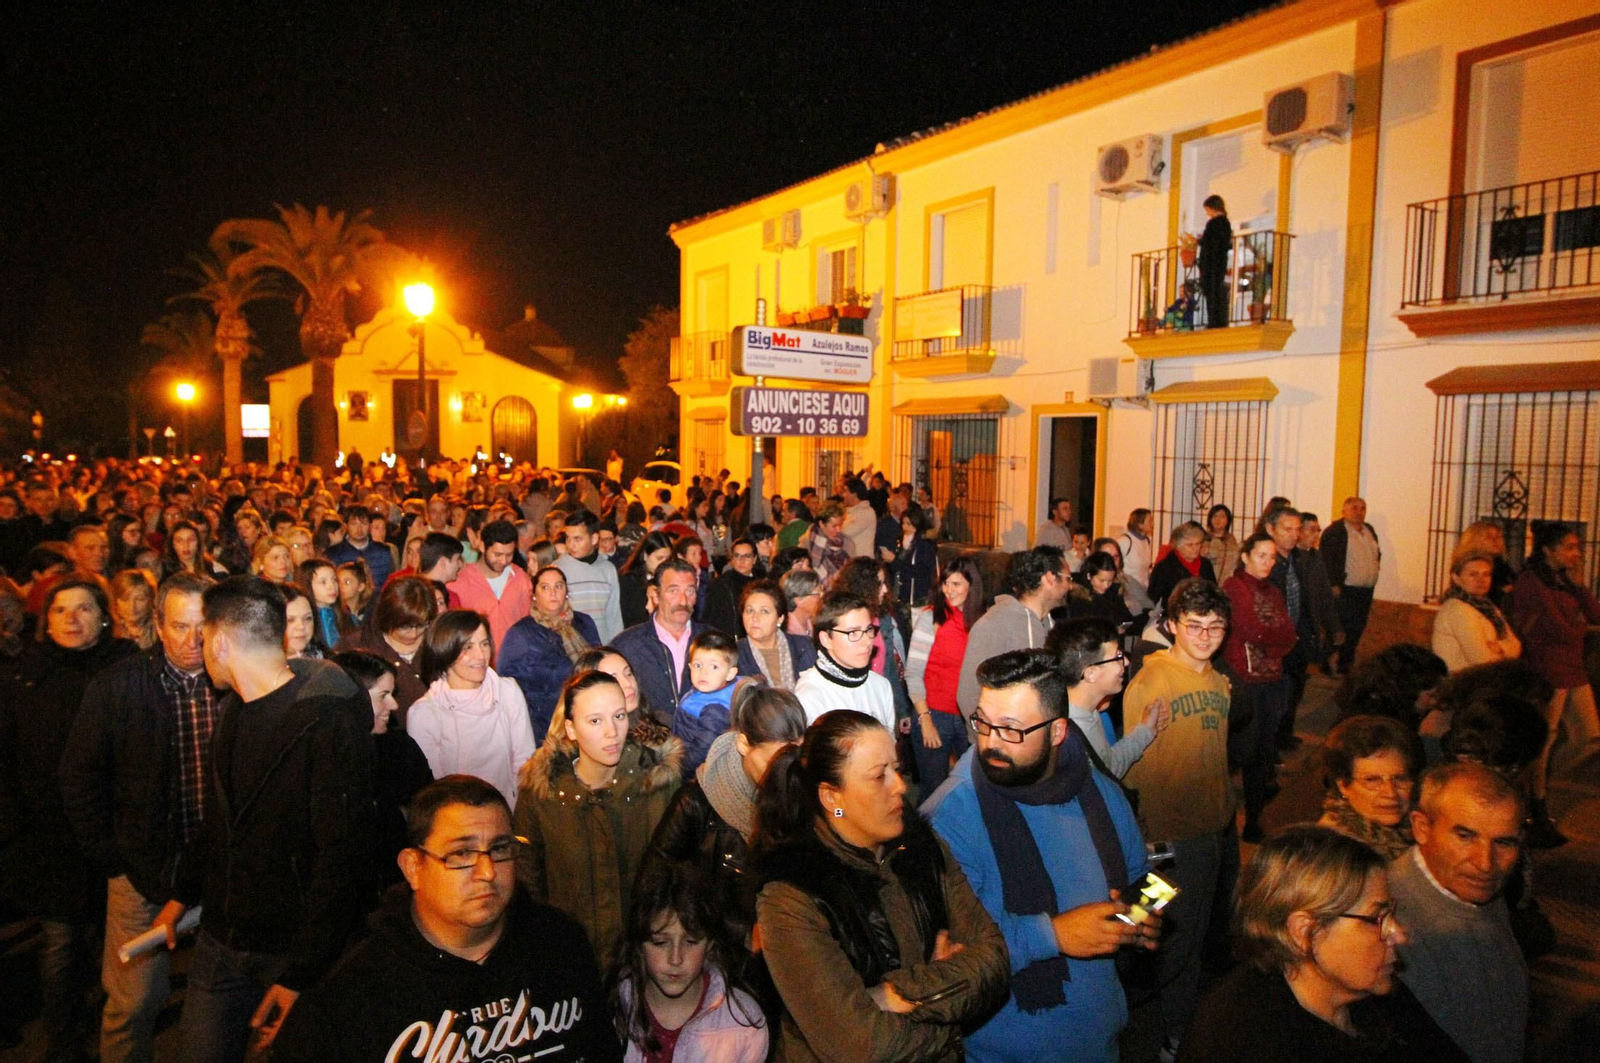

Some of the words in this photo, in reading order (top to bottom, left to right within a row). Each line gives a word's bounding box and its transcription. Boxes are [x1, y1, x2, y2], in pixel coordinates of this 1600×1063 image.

[748, 330, 801, 350] BigMat
[812, 338, 843, 353] Azulejos
[845, 341, 869, 353] Ramos
[747, 389, 830, 415] ANUNCIESE
[832, 393, 865, 417] AQUI
[751, 416, 782, 434] 902
[797, 417, 816, 434] 10
[819, 417, 838, 434] 36
[841, 418, 860, 435] 69
[454, 997, 511, 1024] RUE
